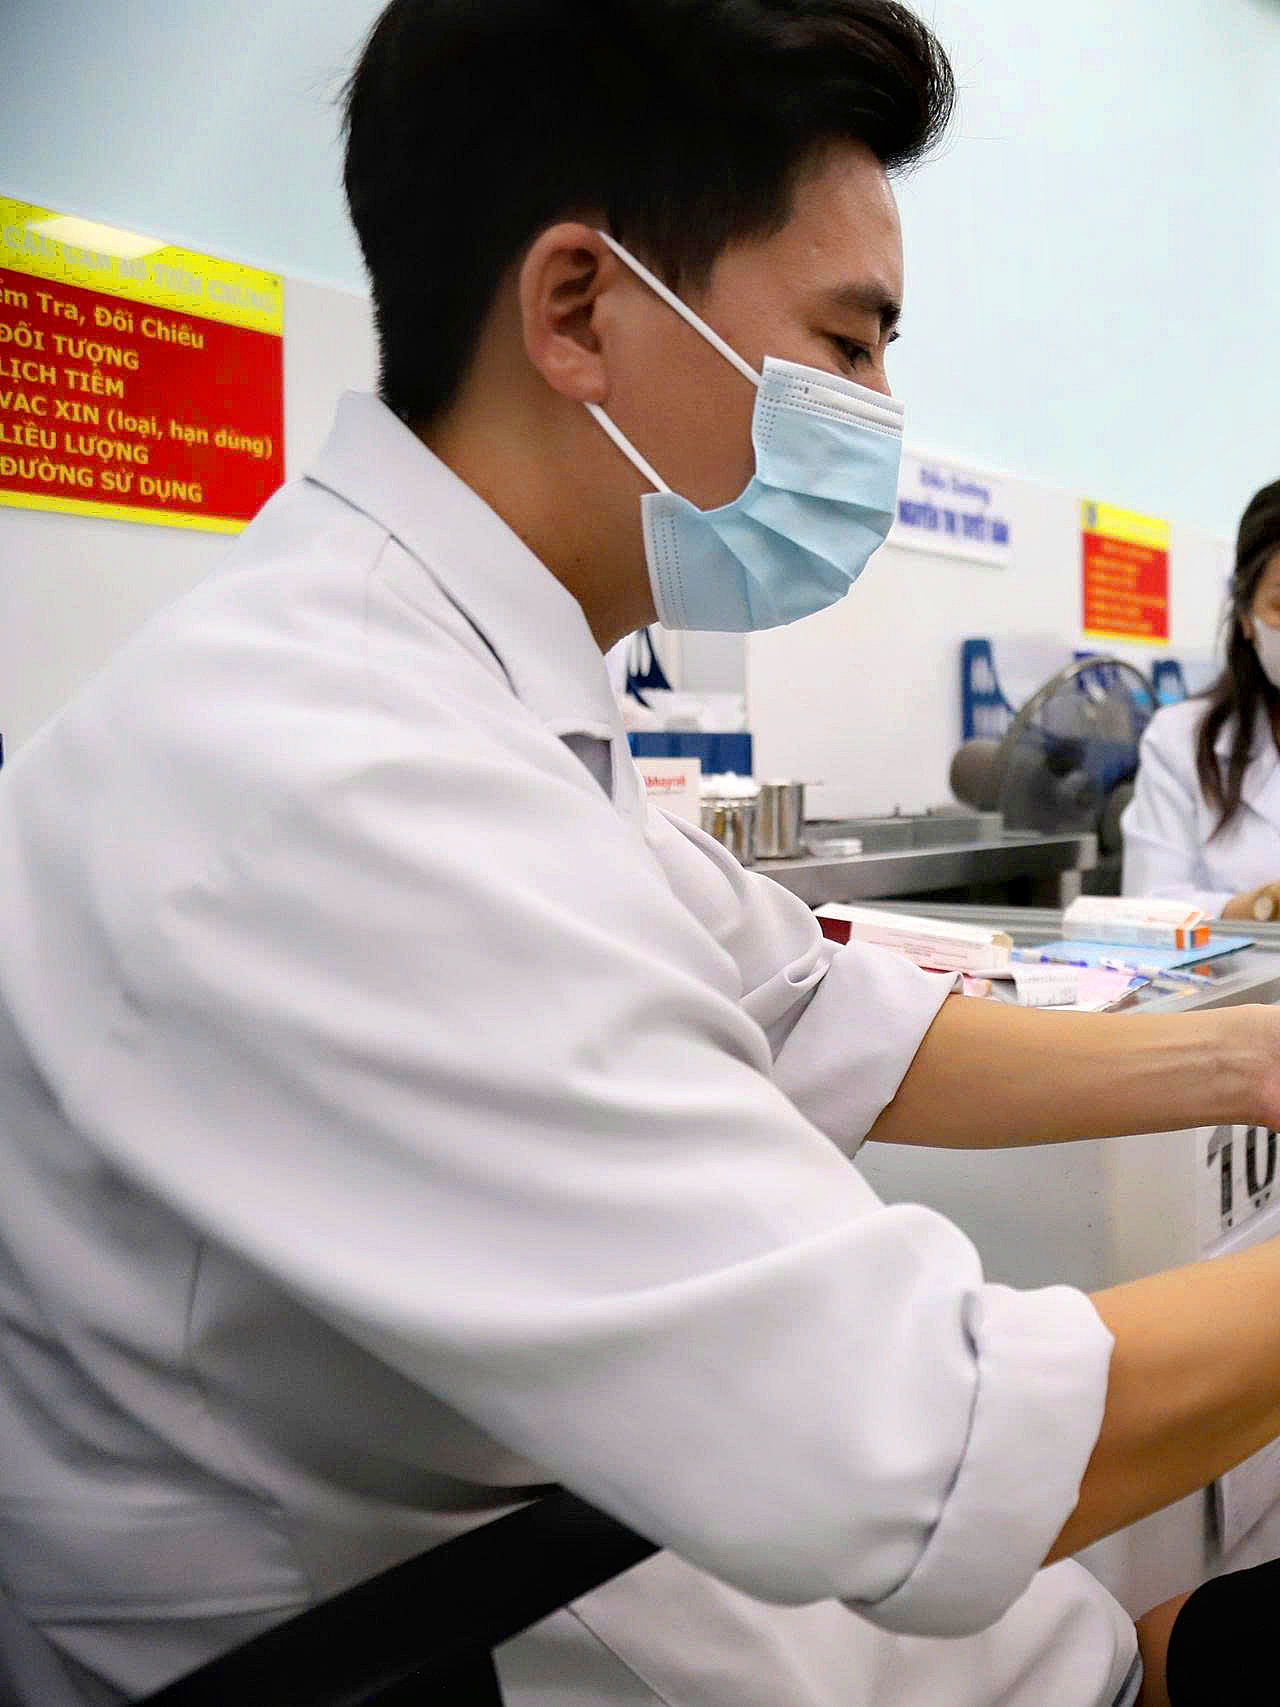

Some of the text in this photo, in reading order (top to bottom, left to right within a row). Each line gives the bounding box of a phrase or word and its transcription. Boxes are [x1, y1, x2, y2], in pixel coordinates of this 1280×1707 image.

[36, 291, 86, 327] Tra,
[52, 334, 139, 371] TƯỢNG
[64, 368, 124, 399] TIÊM
[55, 399, 99, 425] XIN
[107, 408, 164, 440] (loại,
[170, 418, 209, 447] hạn
[65, 433, 149, 465] LƯỢNG
[0, 455, 94, 488] ĐƯỜNG
[139, 476, 203, 504] DỤNG
